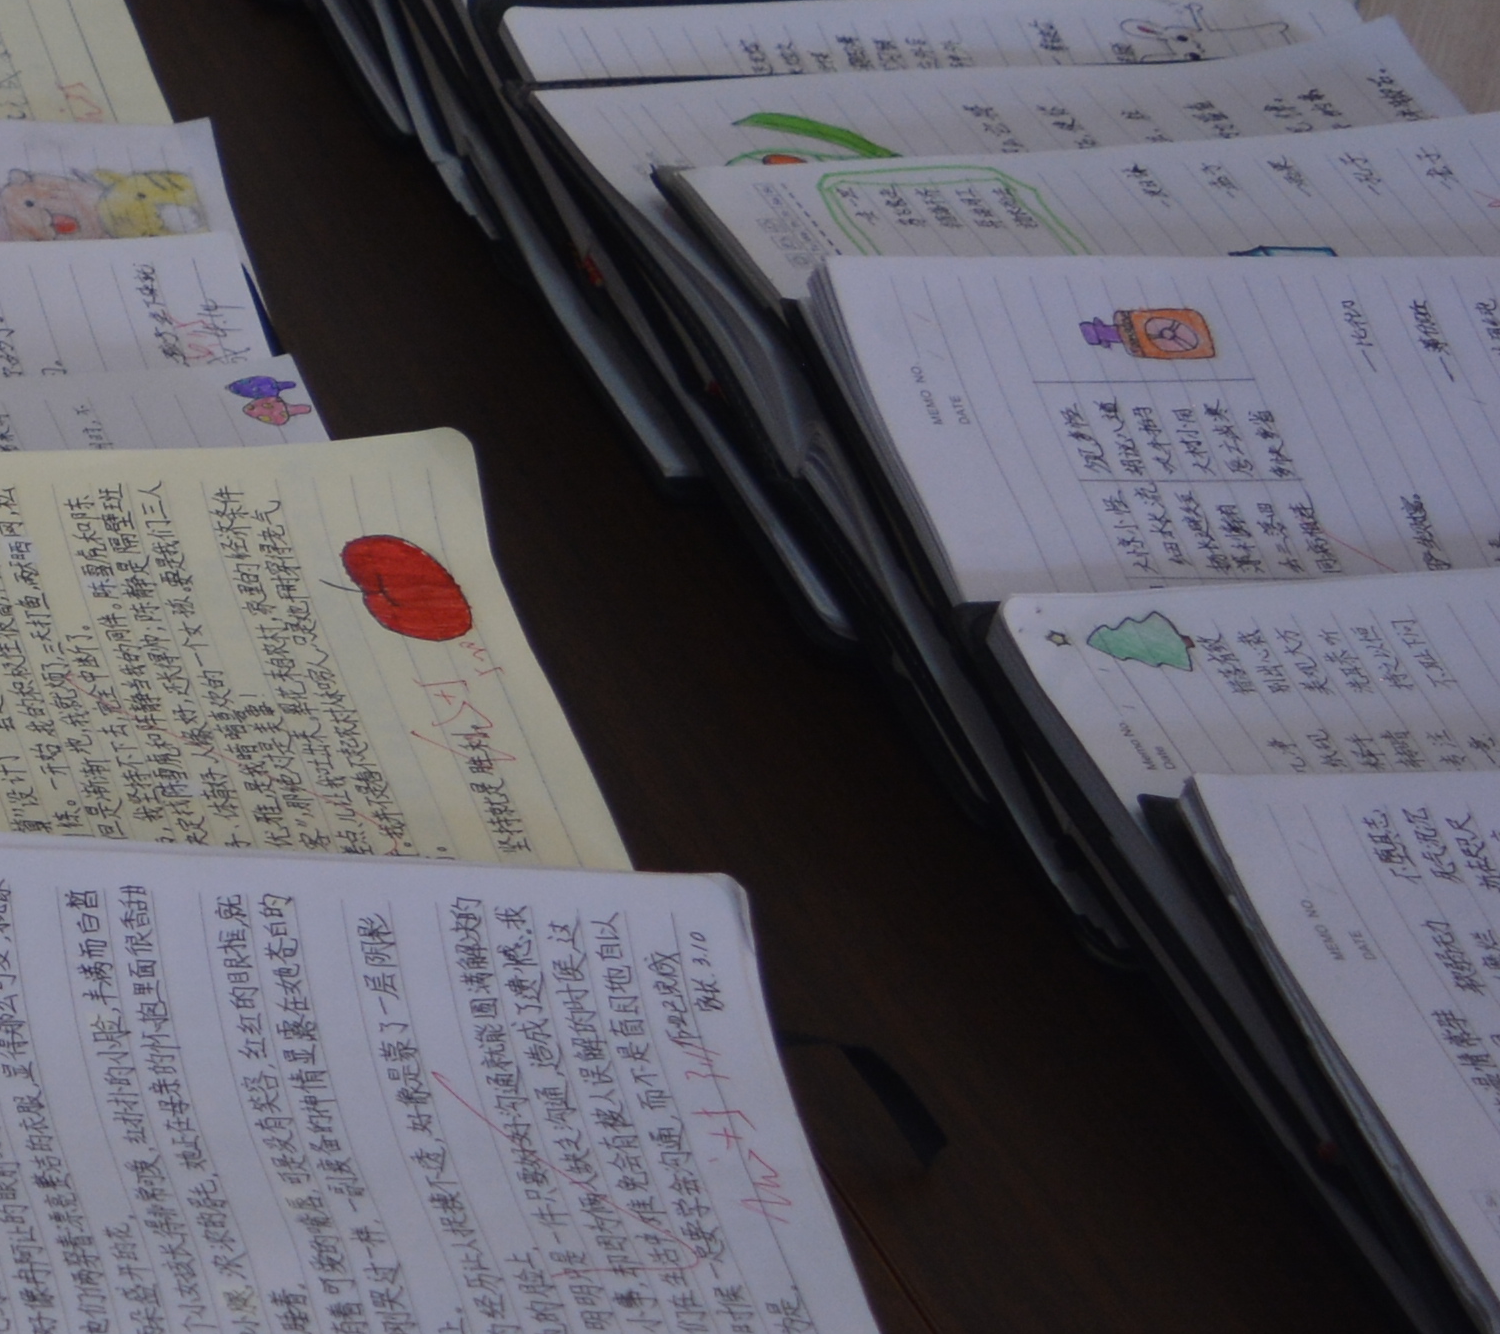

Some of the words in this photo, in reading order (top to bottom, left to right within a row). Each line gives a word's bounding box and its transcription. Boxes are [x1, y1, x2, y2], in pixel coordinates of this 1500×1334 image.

[920, 390, 942, 425] MEMO
[950, 395, 970, 425] DATE
[1128, 740, 1159, 771] Memo
[1152, 746, 1177, 771] Date
[1312, 924, 1345, 961] MEMO
[1348, 930, 1376, 961] DATE
